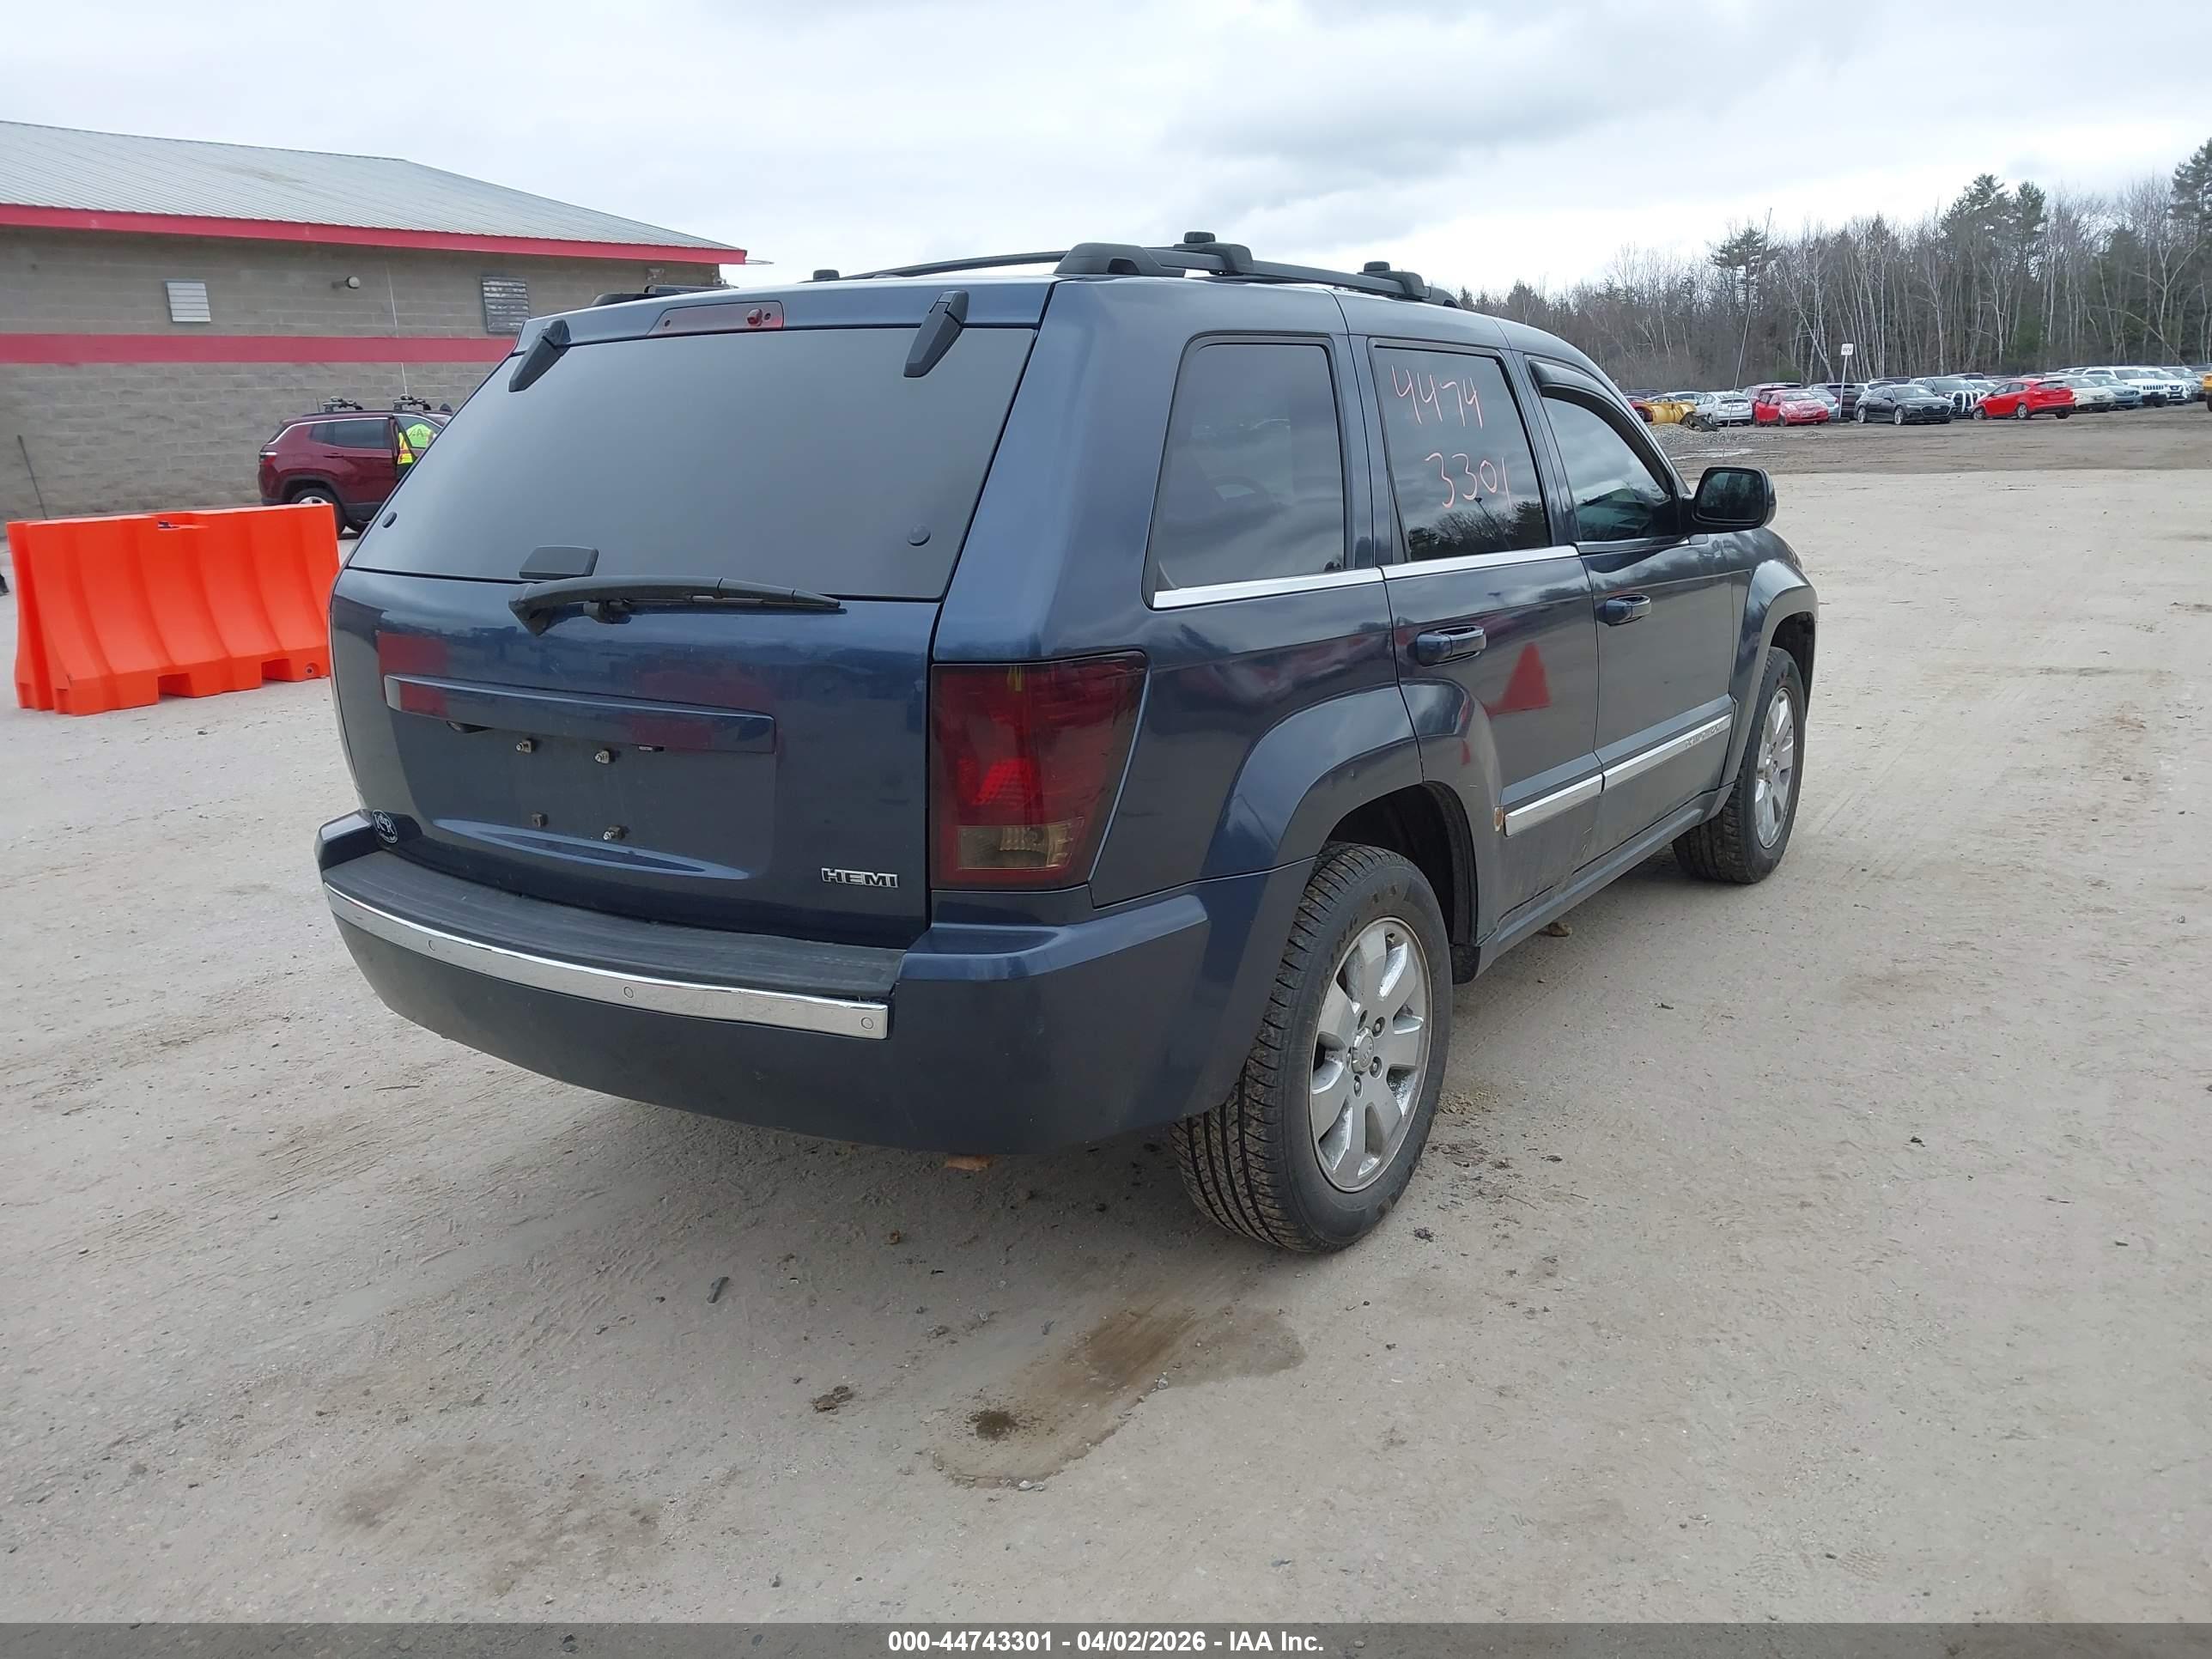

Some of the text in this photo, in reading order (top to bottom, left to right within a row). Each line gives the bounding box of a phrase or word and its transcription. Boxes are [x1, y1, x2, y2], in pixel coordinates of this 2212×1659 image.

[1391, 364, 1484, 429] 4474
[1425, 452, 1512, 511] 3301
[821, 867, 898, 888] HEMI
